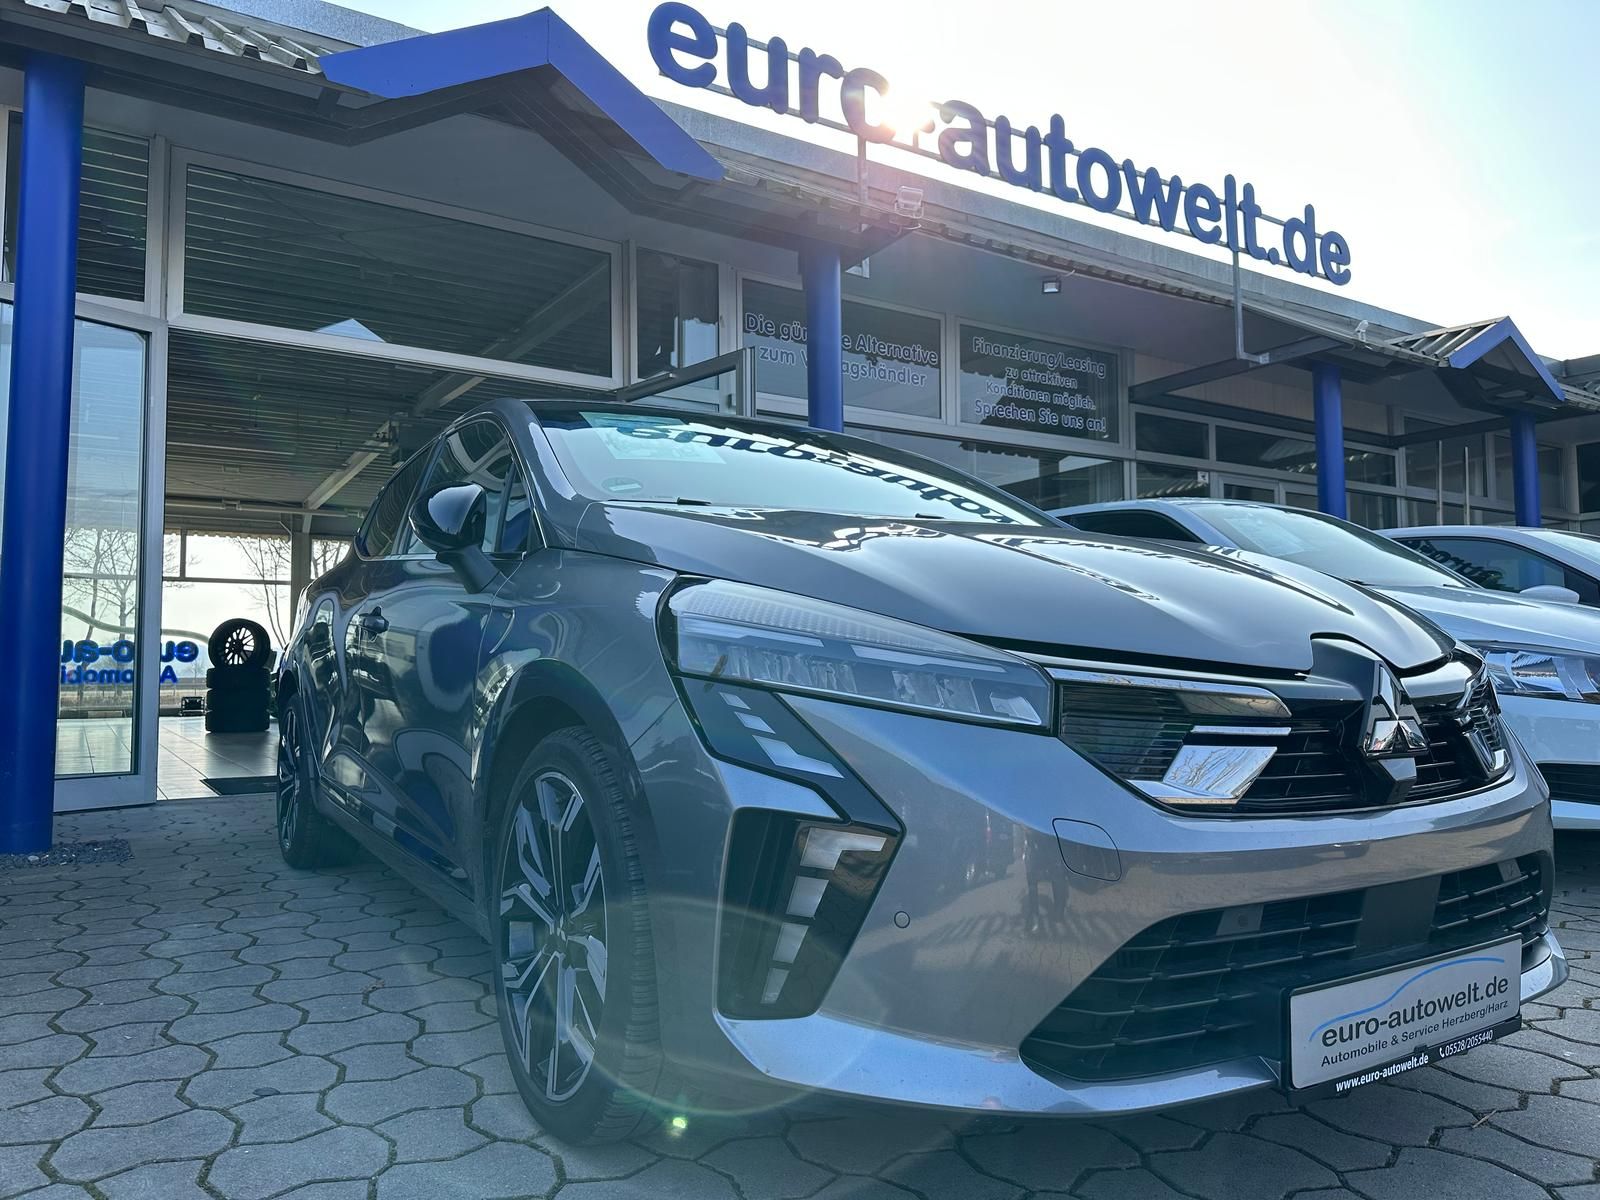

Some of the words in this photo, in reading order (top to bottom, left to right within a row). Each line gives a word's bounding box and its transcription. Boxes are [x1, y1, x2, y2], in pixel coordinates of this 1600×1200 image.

[745, 312, 776, 336] Die
[856, 334, 939, 365] Alternative
[759, 346, 795, 366] zum
[972, 336, 1106, 379] Finanzierung/Leasing
[985, 380, 1050, 402] Konditionen
[1052, 393, 1097, 410] möglich.
[1005, 366, 1018, 379] zu
[1021, 370, 1078, 389] attraktiven
[975, 399, 1035, 422] Sprechen
[1038, 409, 1059, 425] Sie
[1061, 415, 1085, 429] uns
[1086, 418, 1107, 433] an!
[1321, 976, 1509, 1047] euro-autowelt.de
[1321, 1040, 1388, 1067] Automobile
[1390, 1034, 1399, 1046] &
[1401, 1022, 1440, 1043] Service
[1442, 999, 1509, 1029] Herzberg/Harz
[1335, 1052, 1429, 1093] www.euro-autowelt.de
